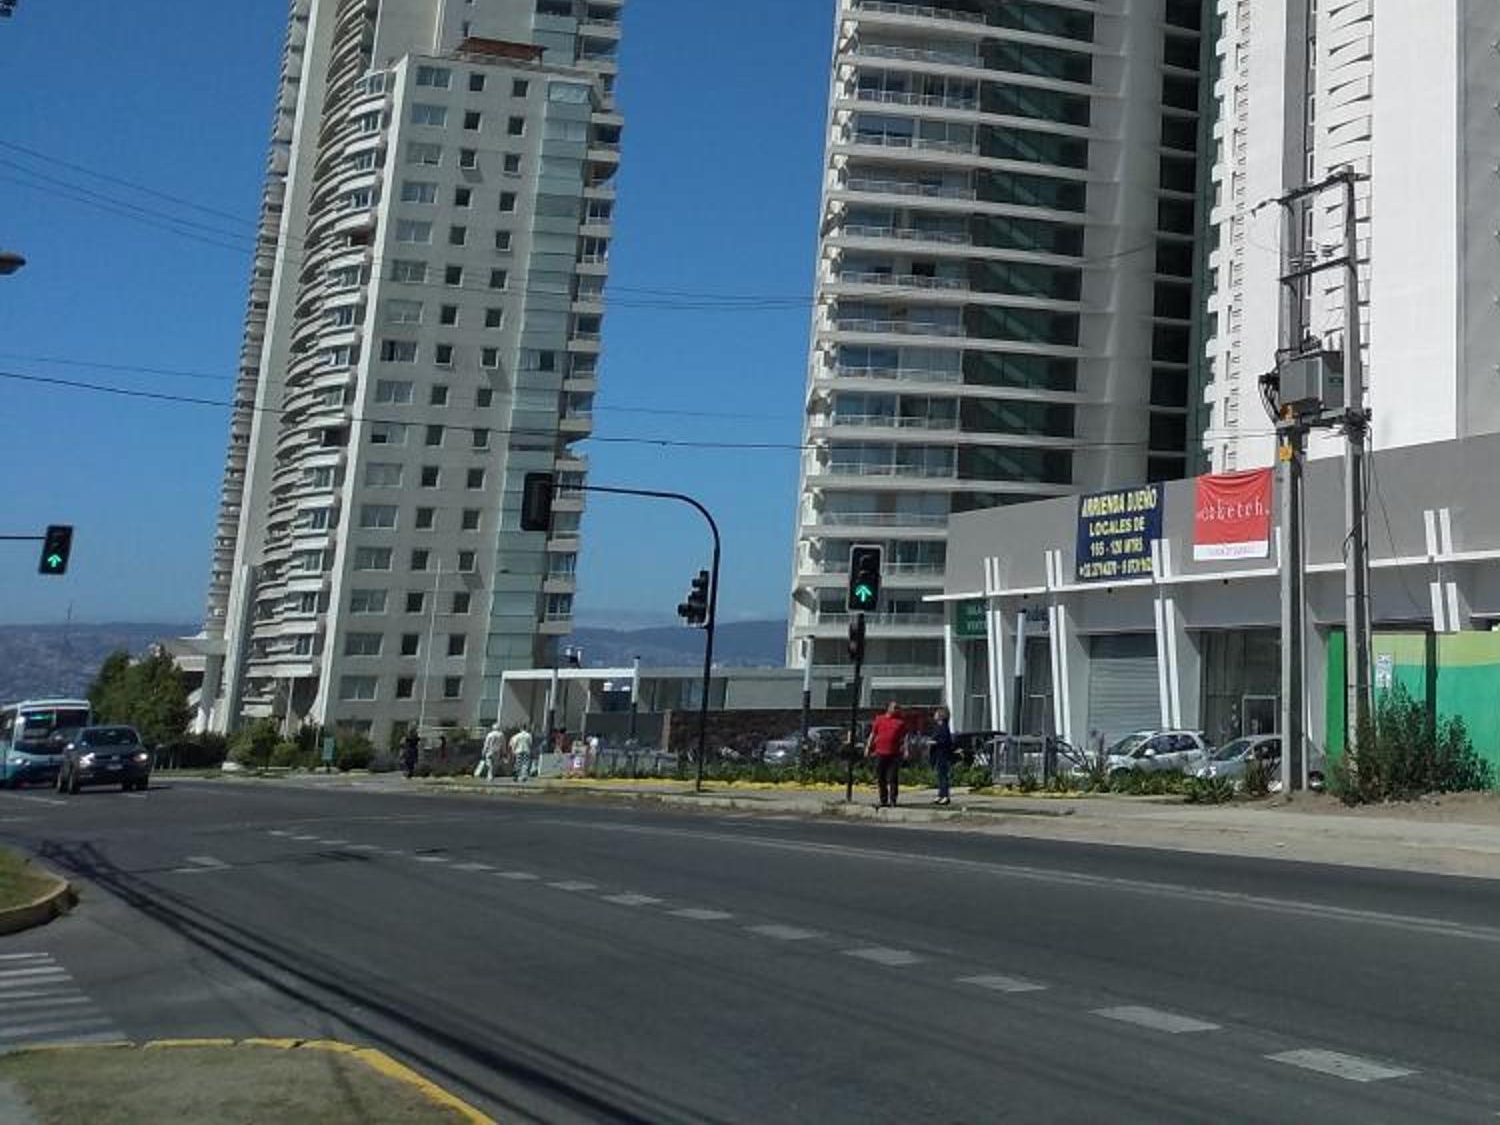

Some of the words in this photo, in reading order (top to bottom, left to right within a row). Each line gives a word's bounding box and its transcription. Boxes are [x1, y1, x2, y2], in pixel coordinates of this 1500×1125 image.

[1081, 492, 1125, 518] ARRIENDA
[1127, 484, 1157, 512] DUEÑO
[1089, 517, 1132, 538] LOCALES
[1133, 515, 1145, 532] DE
